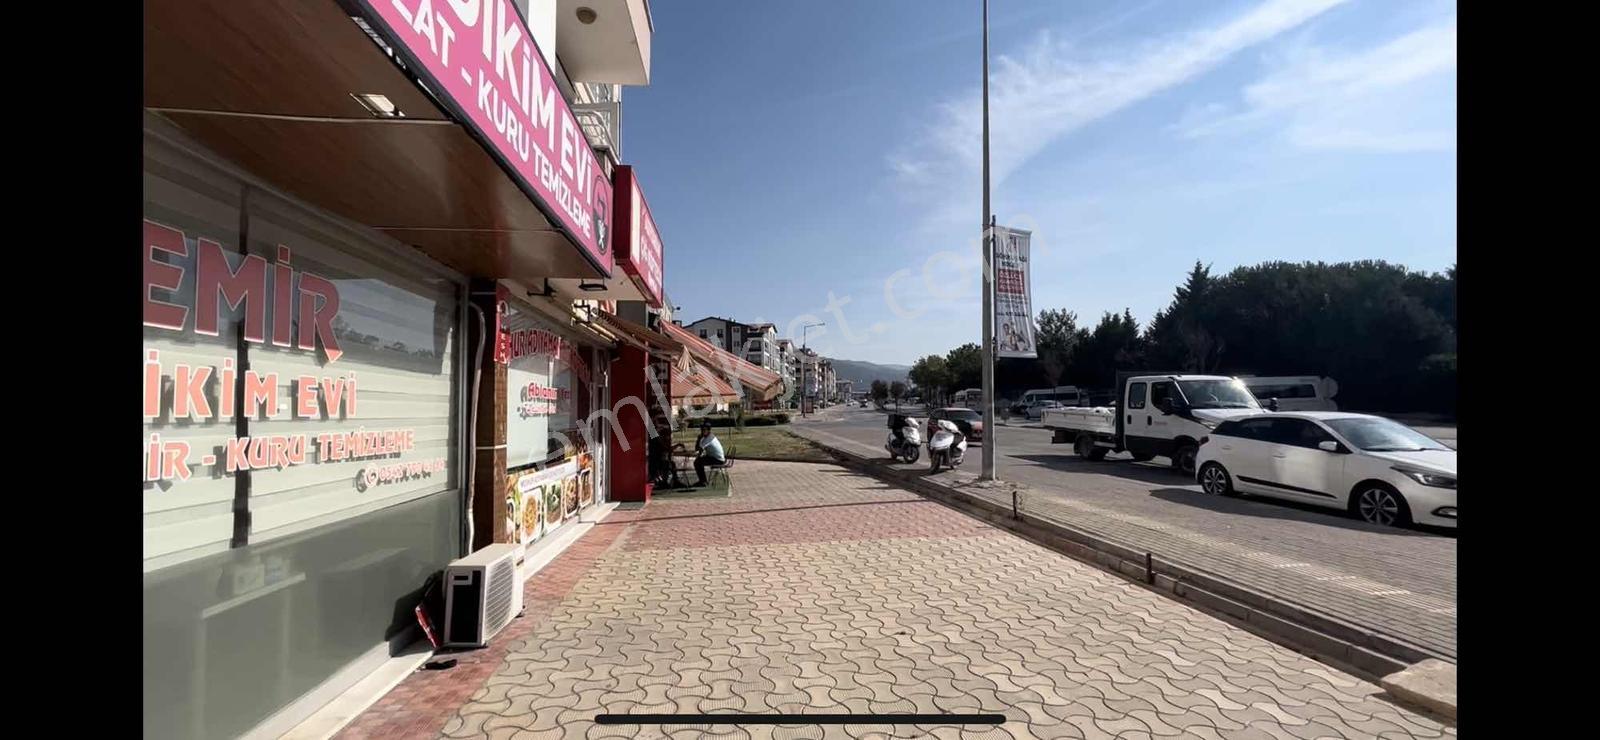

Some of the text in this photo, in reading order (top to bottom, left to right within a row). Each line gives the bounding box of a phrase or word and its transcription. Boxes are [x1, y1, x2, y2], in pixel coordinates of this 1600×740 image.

[478, 70, 530, 163] KURU
[532, 140, 591, 239] TEMİZLEME
[560, 110, 592, 204] EVİ
[143, 218, 344, 364] EMİR
[144, 348, 358, 419] İKİM EVİ
[226, 434, 306, 473] KURU
[317, 426, 416, 461] TEMİZLEME
